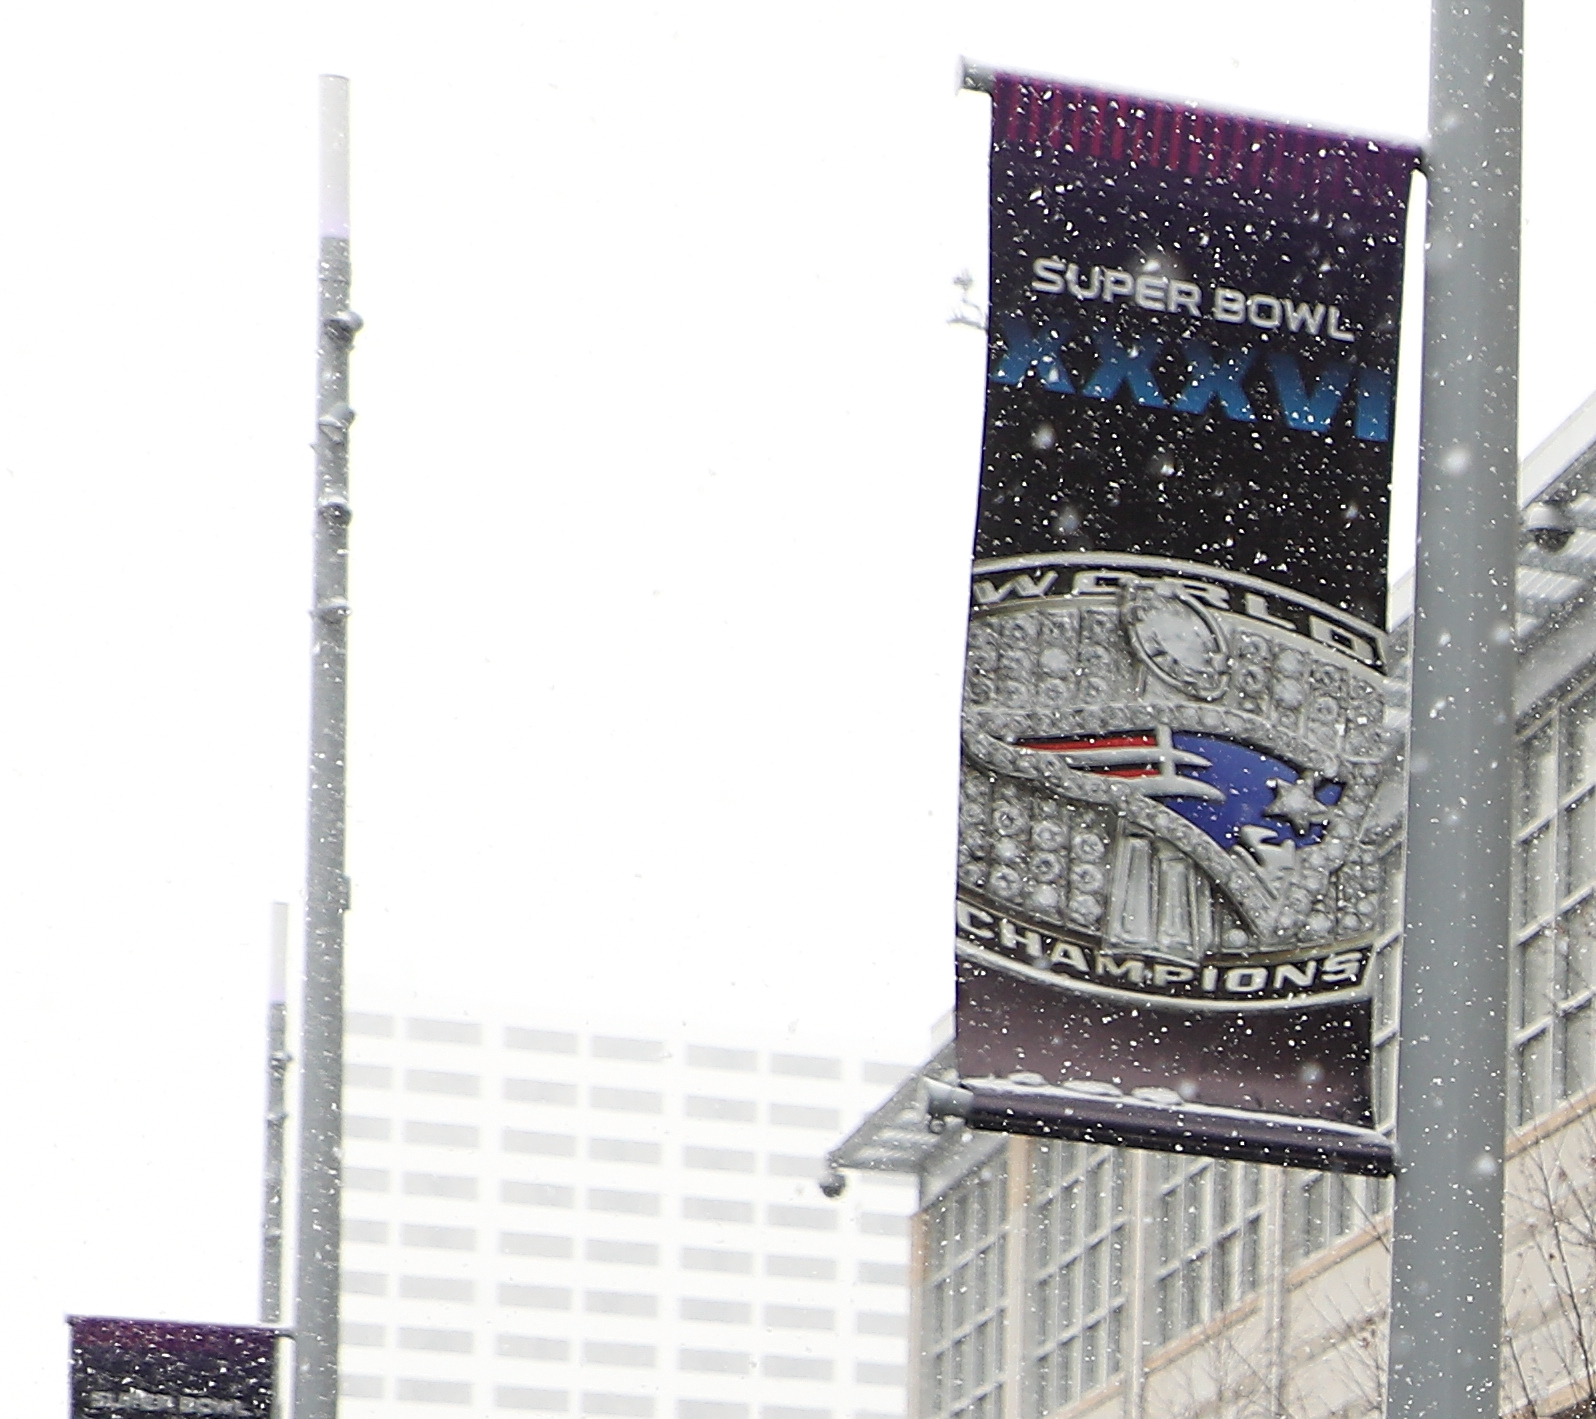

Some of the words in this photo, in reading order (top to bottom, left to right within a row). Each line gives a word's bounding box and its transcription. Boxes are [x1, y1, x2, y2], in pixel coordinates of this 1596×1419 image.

[1032, 256, 1202, 318] SUPER
[1213, 287, 1355, 343] BOWL
[990, 316, 1390, 442] XXXVI
[956, 898, 1363, 993] CHAMPIONS
